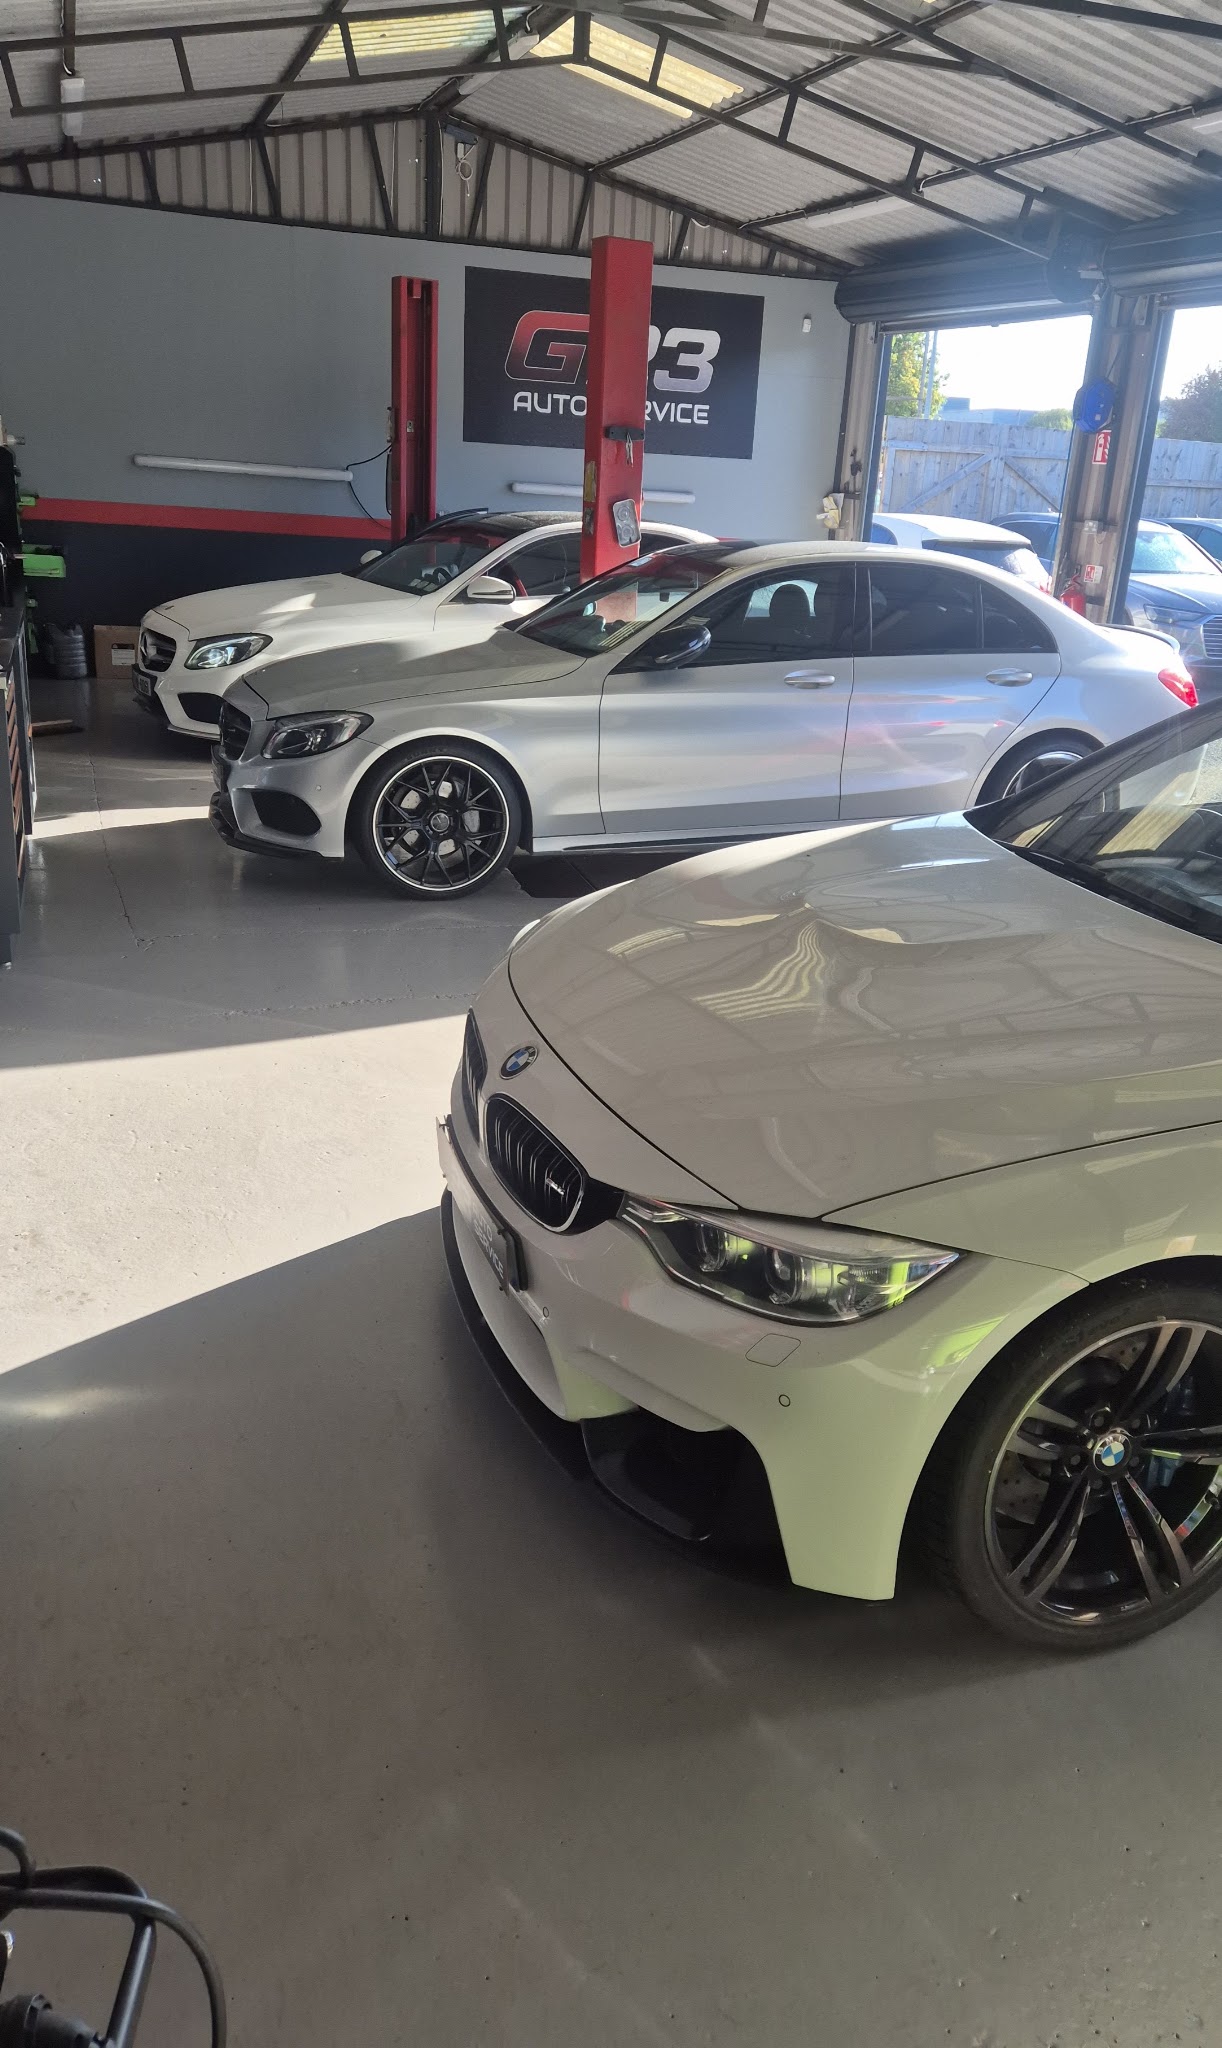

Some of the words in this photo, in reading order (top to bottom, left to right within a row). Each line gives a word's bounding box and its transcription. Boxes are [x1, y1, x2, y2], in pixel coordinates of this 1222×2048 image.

[513, 391, 588, 416] AUTO
[645, 401, 709, 425] VICE
[473, 1219, 505, 1280] SERVICE
[1096, 1435, 1126, 1455] BMW
